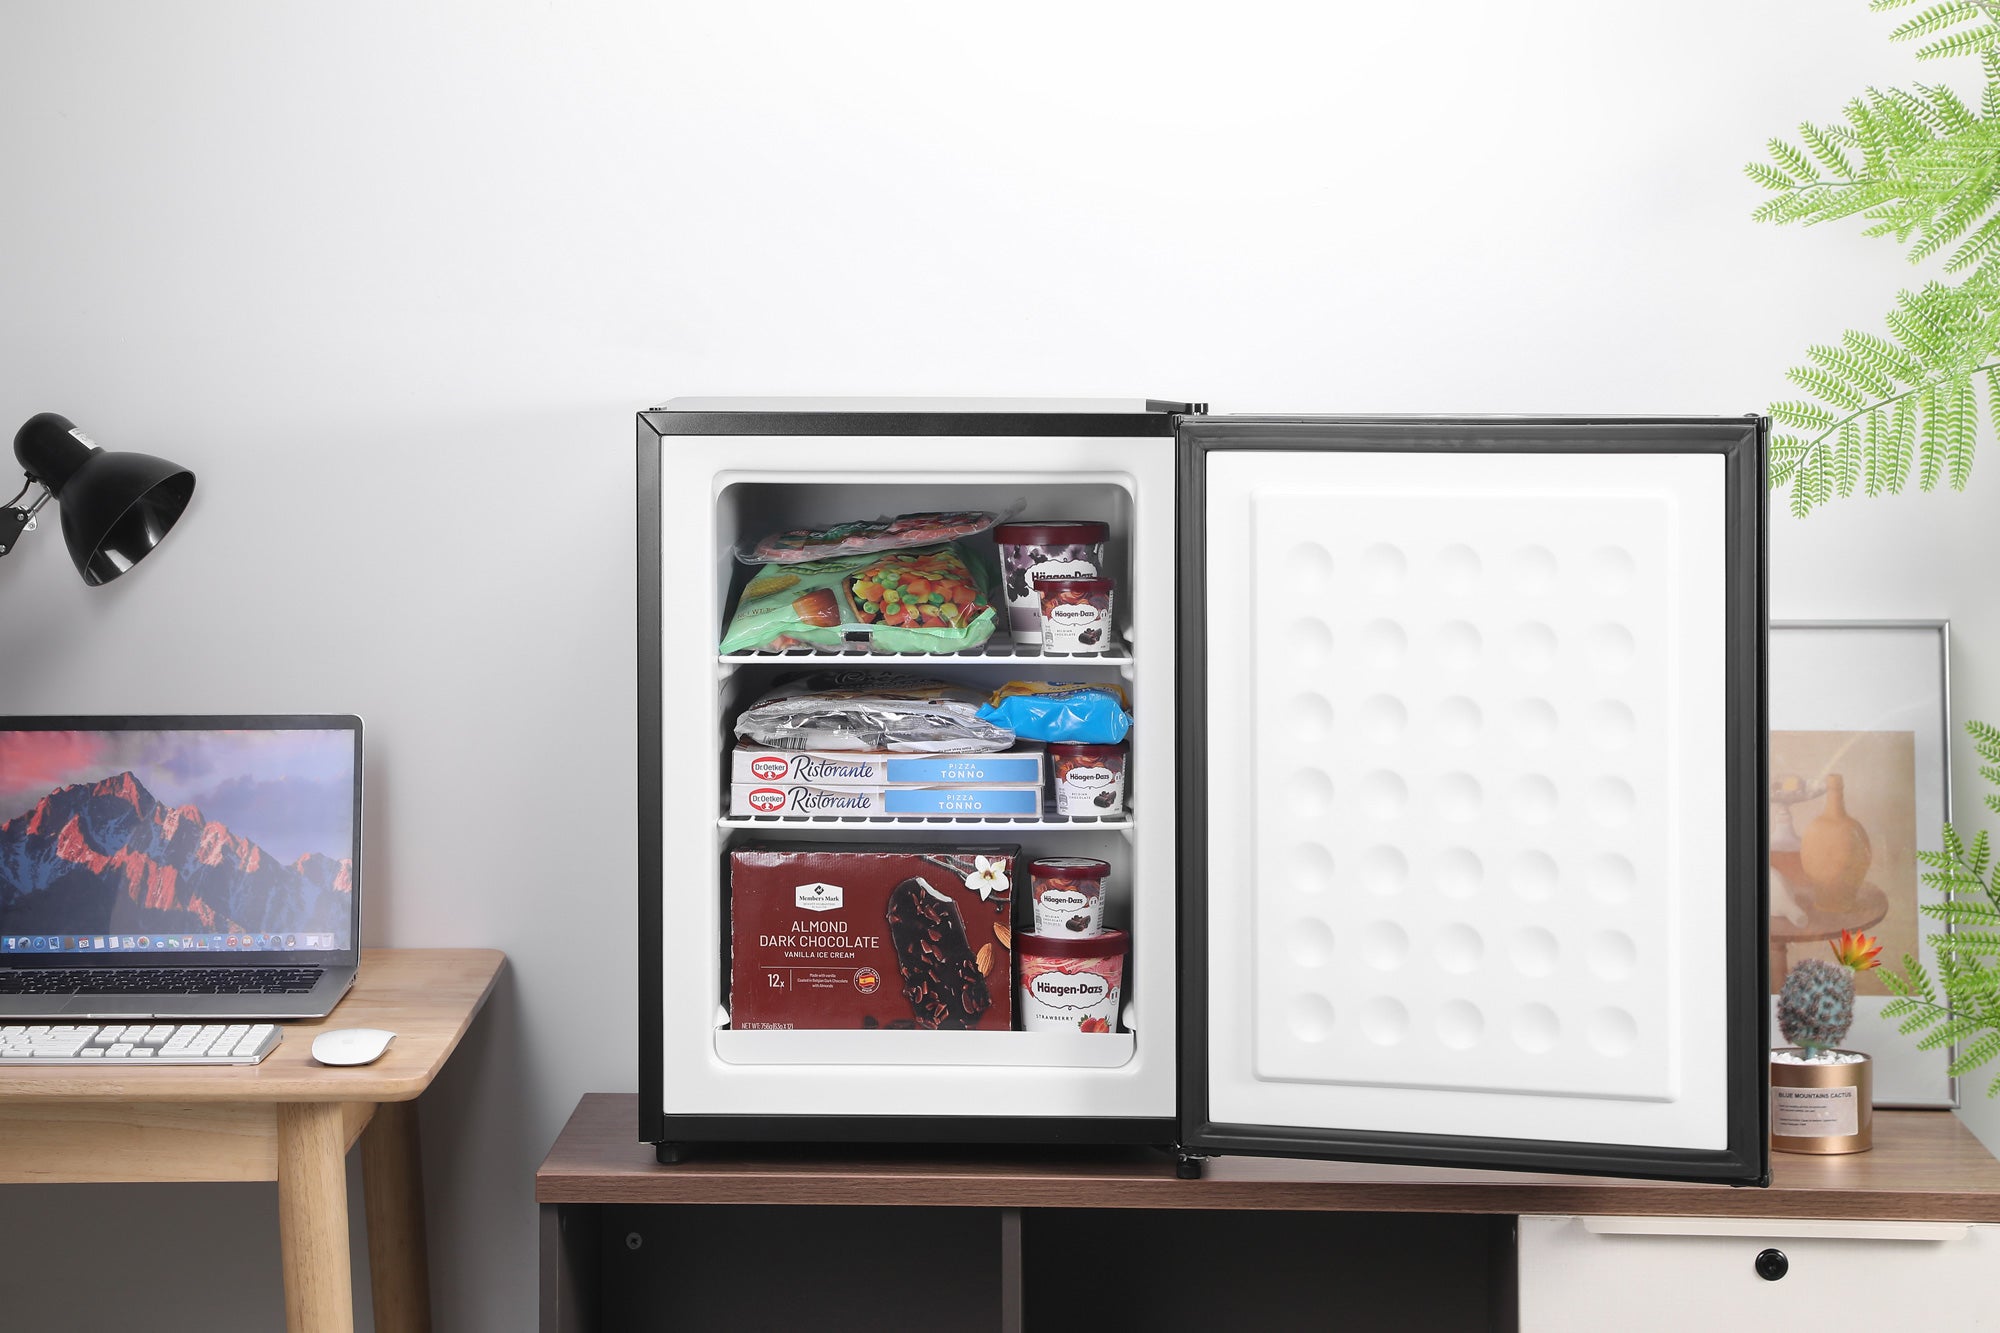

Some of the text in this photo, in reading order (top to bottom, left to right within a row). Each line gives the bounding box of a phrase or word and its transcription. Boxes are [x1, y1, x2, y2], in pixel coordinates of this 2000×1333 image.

[790, 754, 874, 782] Ristorante
[941, 770, 984, 778] TONNO
[788, 786, 871, 813] Ristorante
[791, 921, 848, 933] ALMOND
[760, 935, 880, 948] DARK CHOCOLATE
[1037, 982, 1103, 996] Häagen-Dazs
